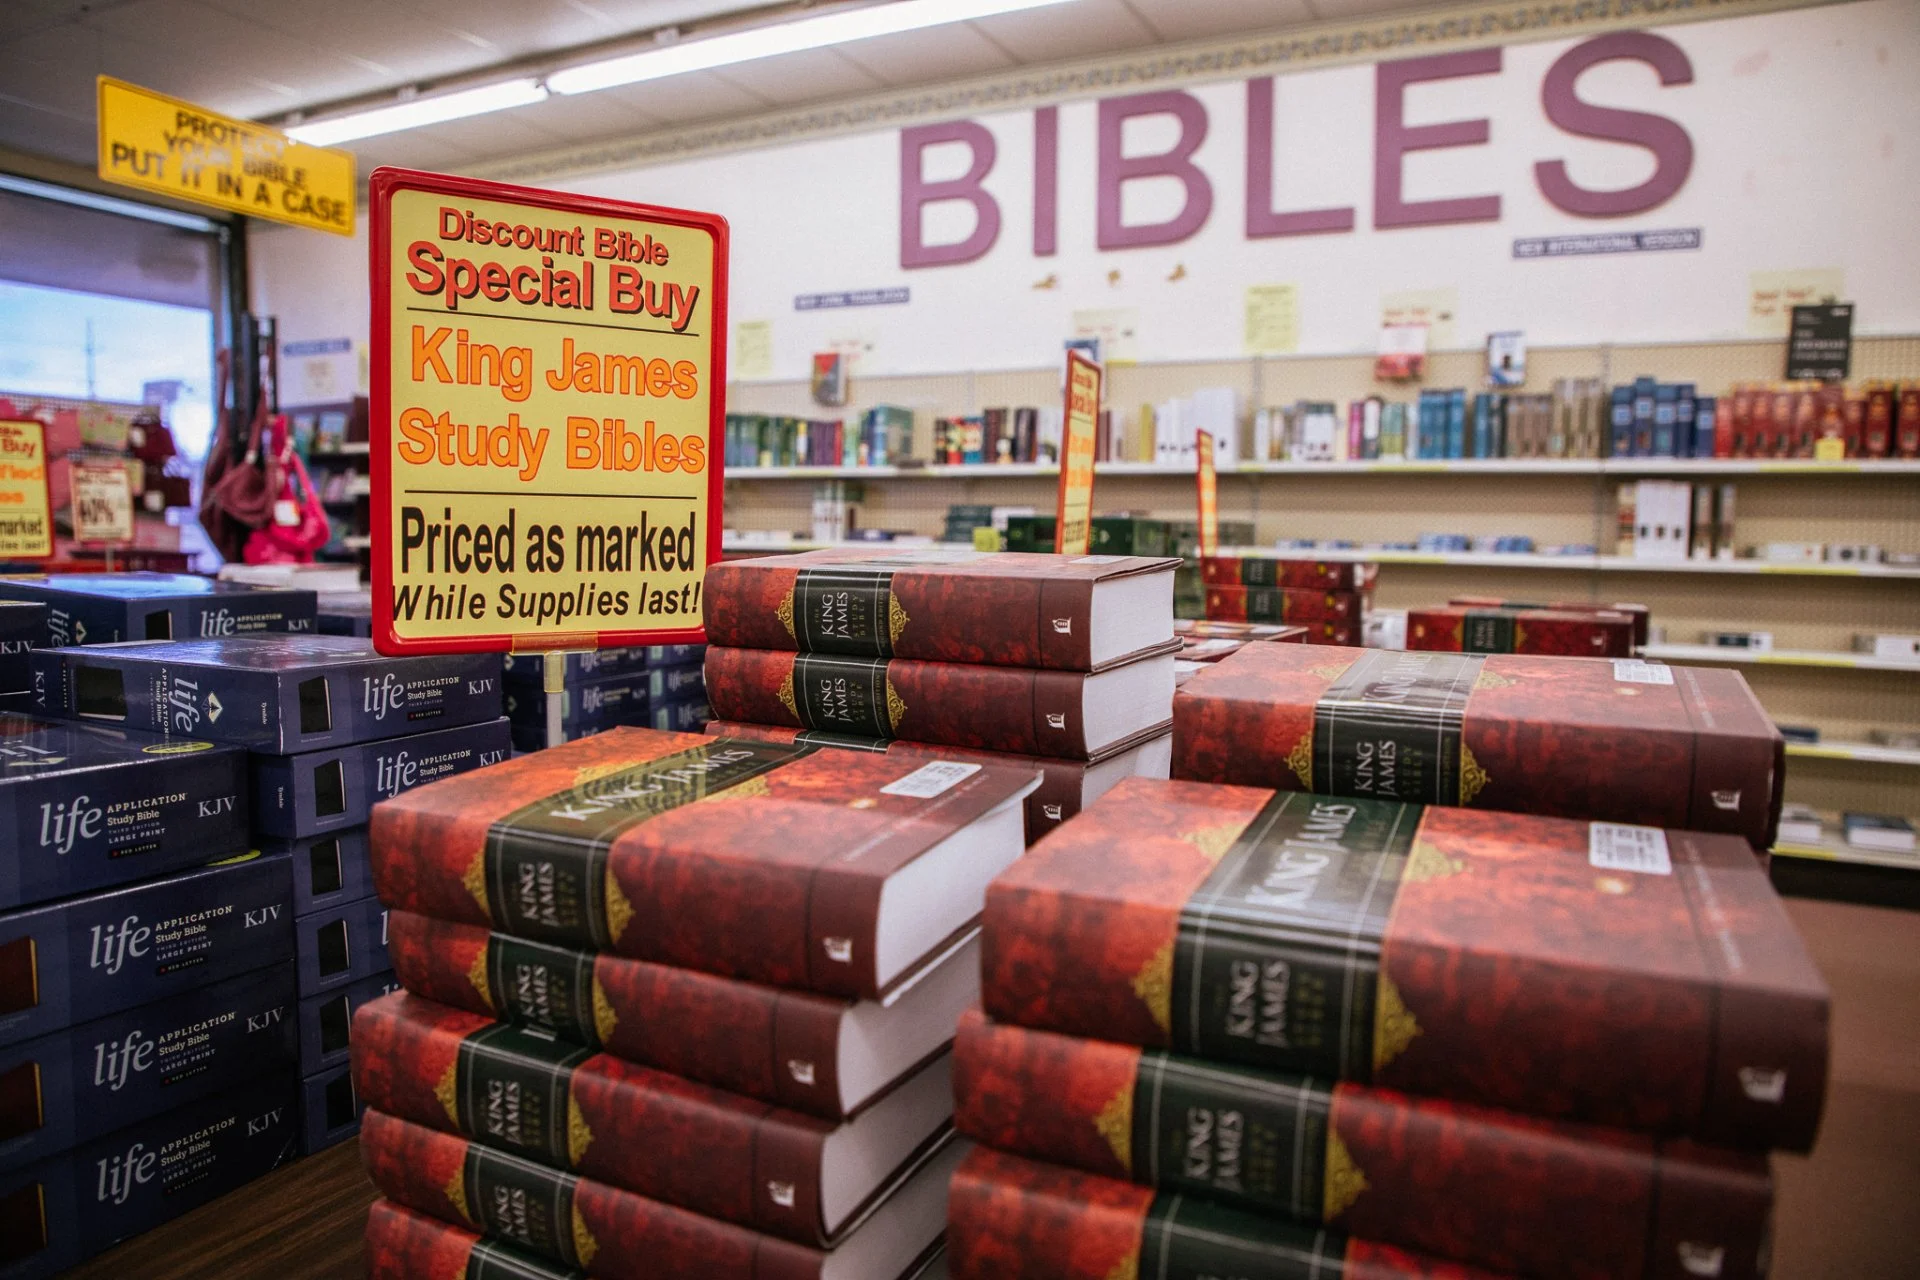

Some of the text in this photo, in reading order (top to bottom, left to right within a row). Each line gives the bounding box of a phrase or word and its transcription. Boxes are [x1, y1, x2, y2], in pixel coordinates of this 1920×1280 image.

[176, 110, 285, 160] PROTECT
[899, 29, 1695, 270] BIBLES
[111, 142, 346, 225] PUT IT IN A CASE
[163, 131, 307, 189] YOUR BIBLE
[439, 207, 669, 266] Discount Bible
[406, 240, 699, 332] Special Buy
[411, 325, 699, 402] King James
[398, 407, 706, 482] Study Bibles
[401, 506, 696, 574] Priced as marked
[200, 608, 235, 637] life
[288, 619, 311, 631] KJV
[393, 581, 700, 626] While Supplies last!
[821, 594, 834, 635] KING
[836, 592, 852, 640] JAMES
[0, 641, 34, 654] KJV
[48, 609, 70, 648] life
[35, 671, 45, 708] KJV
[169, 678, 200, 732] life
[363, 673, 404, 720] life
[407, 676, 460, 689] APPLICATION
[407, 689, 443, 701] Study Bible
[468, 678, 494, 695] KJV
[821, 680, 836, 718] KING
[835, 678, 854, 723] JAMES
[376, 751, 416, 799] life
[420, 749, 471, 766] APPLICATION
[420, 763, 454, 777] Study Bible
[479, 750, 504, 766] KJV
[1354, 741, 1374, 791] KING
[1377, 740, 1399, 796] JAMES
[107, 793, 186, 814] APPLICATION
[197, 796, 236, 818] KJV
[550, 749, 755, 822] KING JAMES
[40, 795, 101, 855] life
[107, 810, 159, 826] Study Bible
[108, 828, 166, 844] LARGE PRINT
[1244, 802, 1356, 909] KING JAMES
[518, 863, 539, 919] KING
[537, 862, 561, 927] JAMES
[155, 924, 207, 944] Study Bible
[156, 905, 233, 931] APPLICATION
[244, 904, 281, 928] KJV
[90, 915, 150, 975] life
[156, 941, 213, 961] LARGE PRINT
[516, 964, 536, 1018] KING
[532, 964, 554, 1025] JAMES
[1225, 960, 1259, 1039] KING
[1255, 958, 1290, 1048] JAMES
[159, 1012, 236, 1044] APPLICATION
[247, 1006, 284, 1033] KJV
[94, 1030, 154, 1091] life
[159, 1032, 210, 1056] Study Bible
[160, 1049, 216, 1072] LARGE PRINT
[247, 1108, 282, 1136] KJV
[488, 1079, 504, 1136] KING
[504, 1080, 523, 1145] JAMES
[160, 1117, 236, 1155] APPLICATION
[160, 1140, 211, 1167] Study Bible
[1184, 1106, 1214, 1181] KING
[1212, 1109, 1244, 1194] JAMES
[97, 1143, 156, 1205] life
[163, 1155, 217, 1183] LARGE PRINT
[495, 1185, 516, 1237] KING
[511, 1188, 533, 1245] JAMES
